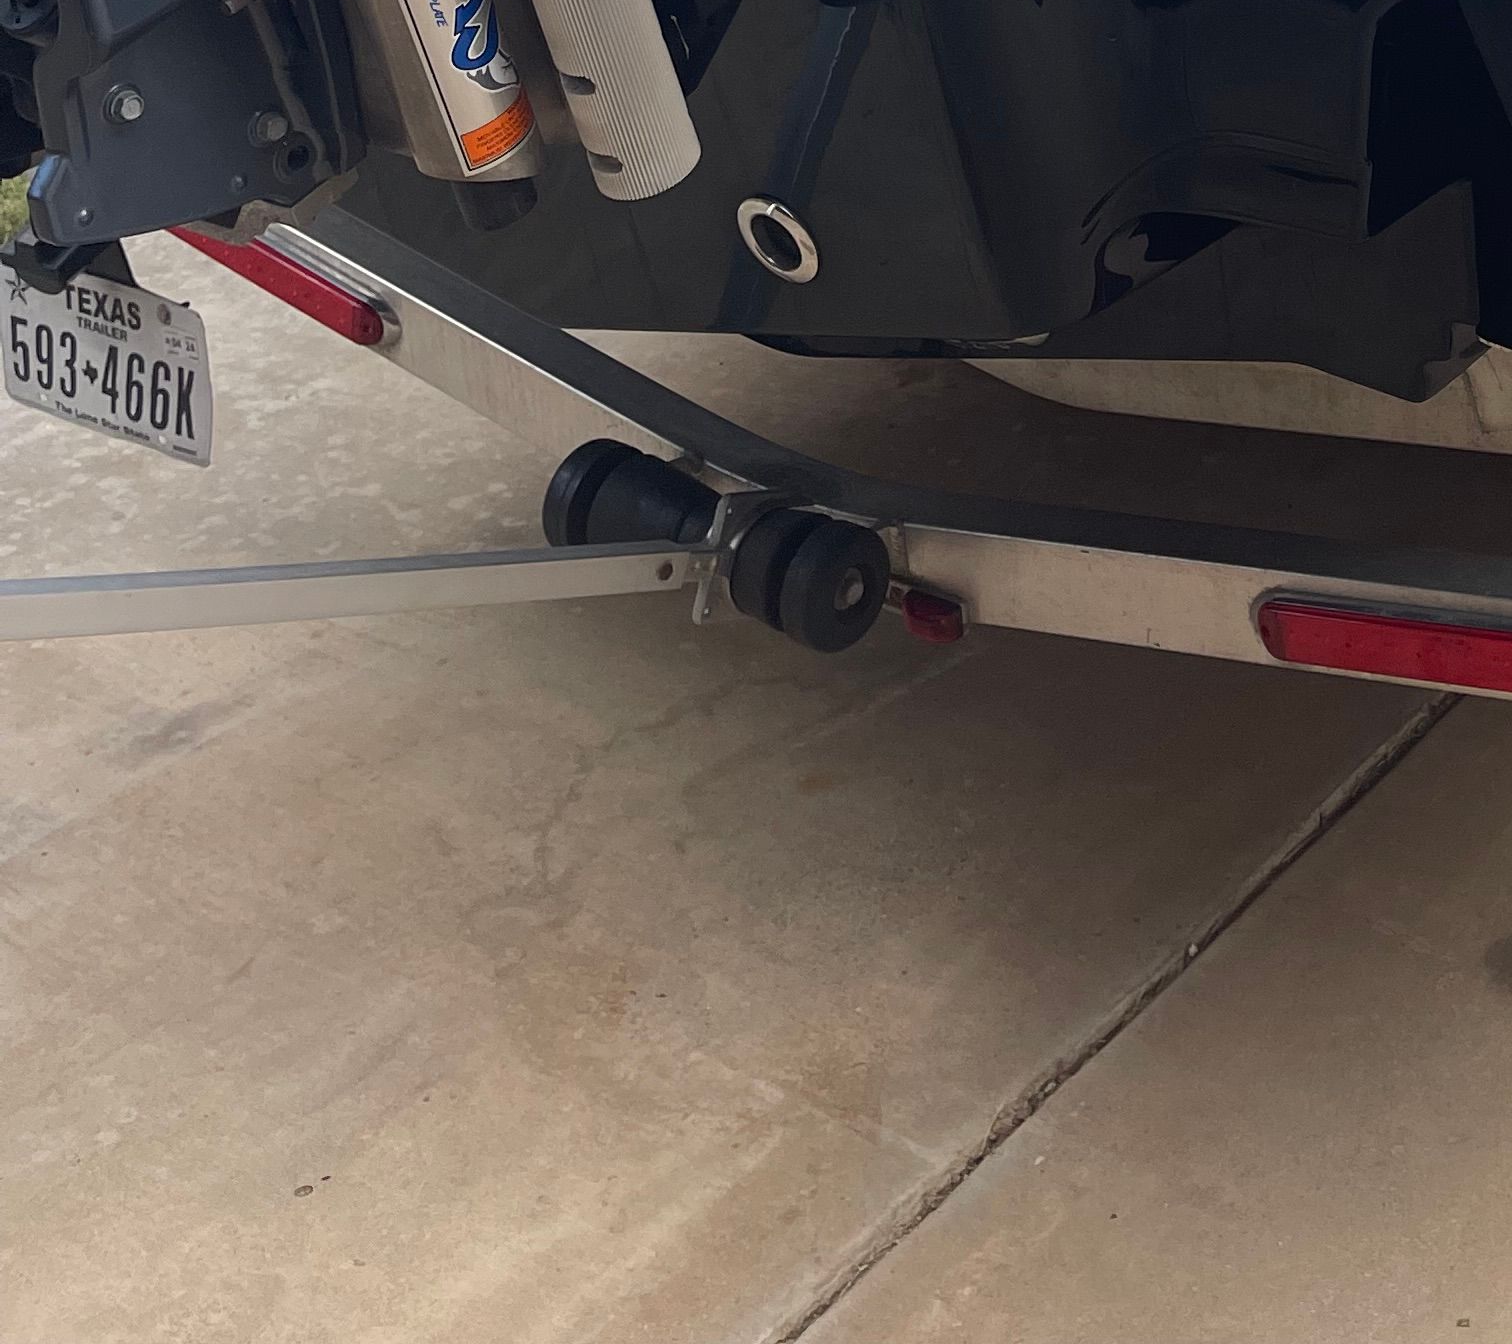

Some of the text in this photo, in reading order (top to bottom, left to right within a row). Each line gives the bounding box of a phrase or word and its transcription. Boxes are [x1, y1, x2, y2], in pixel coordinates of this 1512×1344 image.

[65, 284, 141, 331] TEXAS
[76, 315, 128, 342] TRAILER
[11, 315, 195, 440] 593 466K
